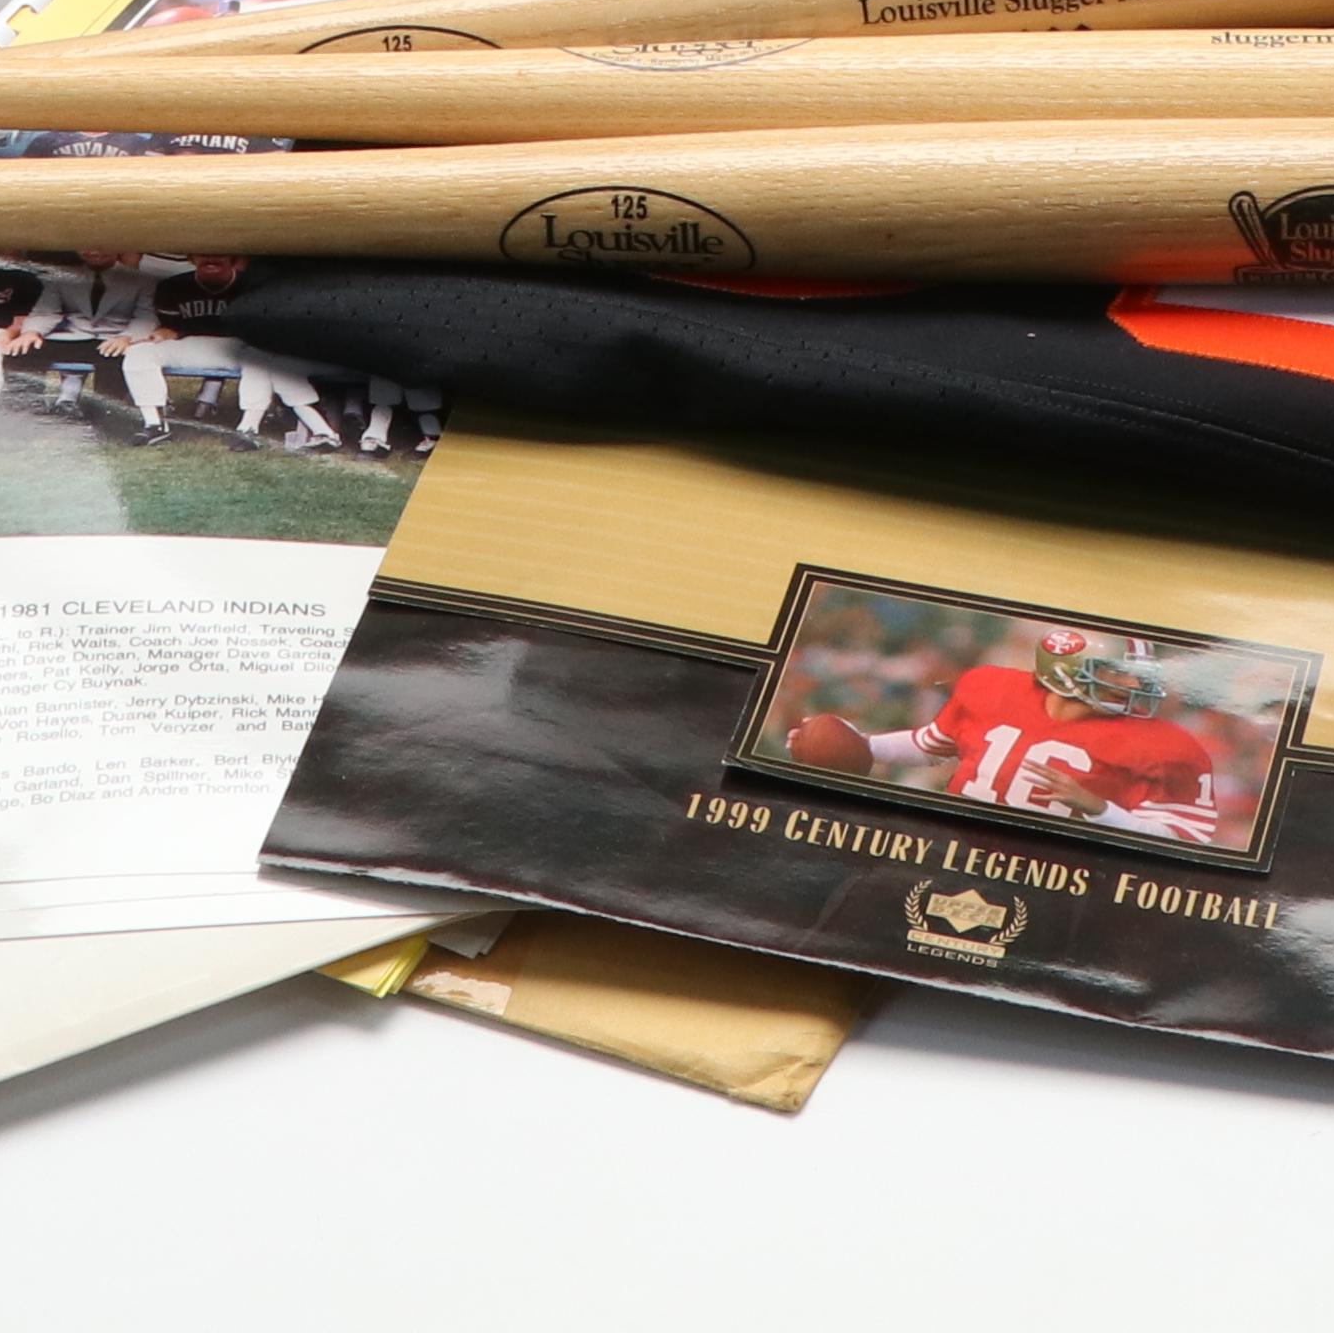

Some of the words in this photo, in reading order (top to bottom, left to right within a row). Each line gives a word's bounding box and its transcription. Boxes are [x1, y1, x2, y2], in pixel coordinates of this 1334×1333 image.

[382, 34, 414, 53] 125
[609, 194, 649, 222] 125
[540, 213, 725, 257] Louisville
[0, 603, 52, 619] 1981
[61, 599, 214, 616] CLEVELAND
[222, 599, 327, 618] INDIANS
[261, 624, 336, 639] Traveling
[687, 792, 771, 834] 1999
[784, 808, 934, 868] CENTURY
[942, 840, 1090, 896] LEGENDS
[1113, 872, 1279, 931] FOOTBALL
[907, 943, 998, 968] LEGENDS
